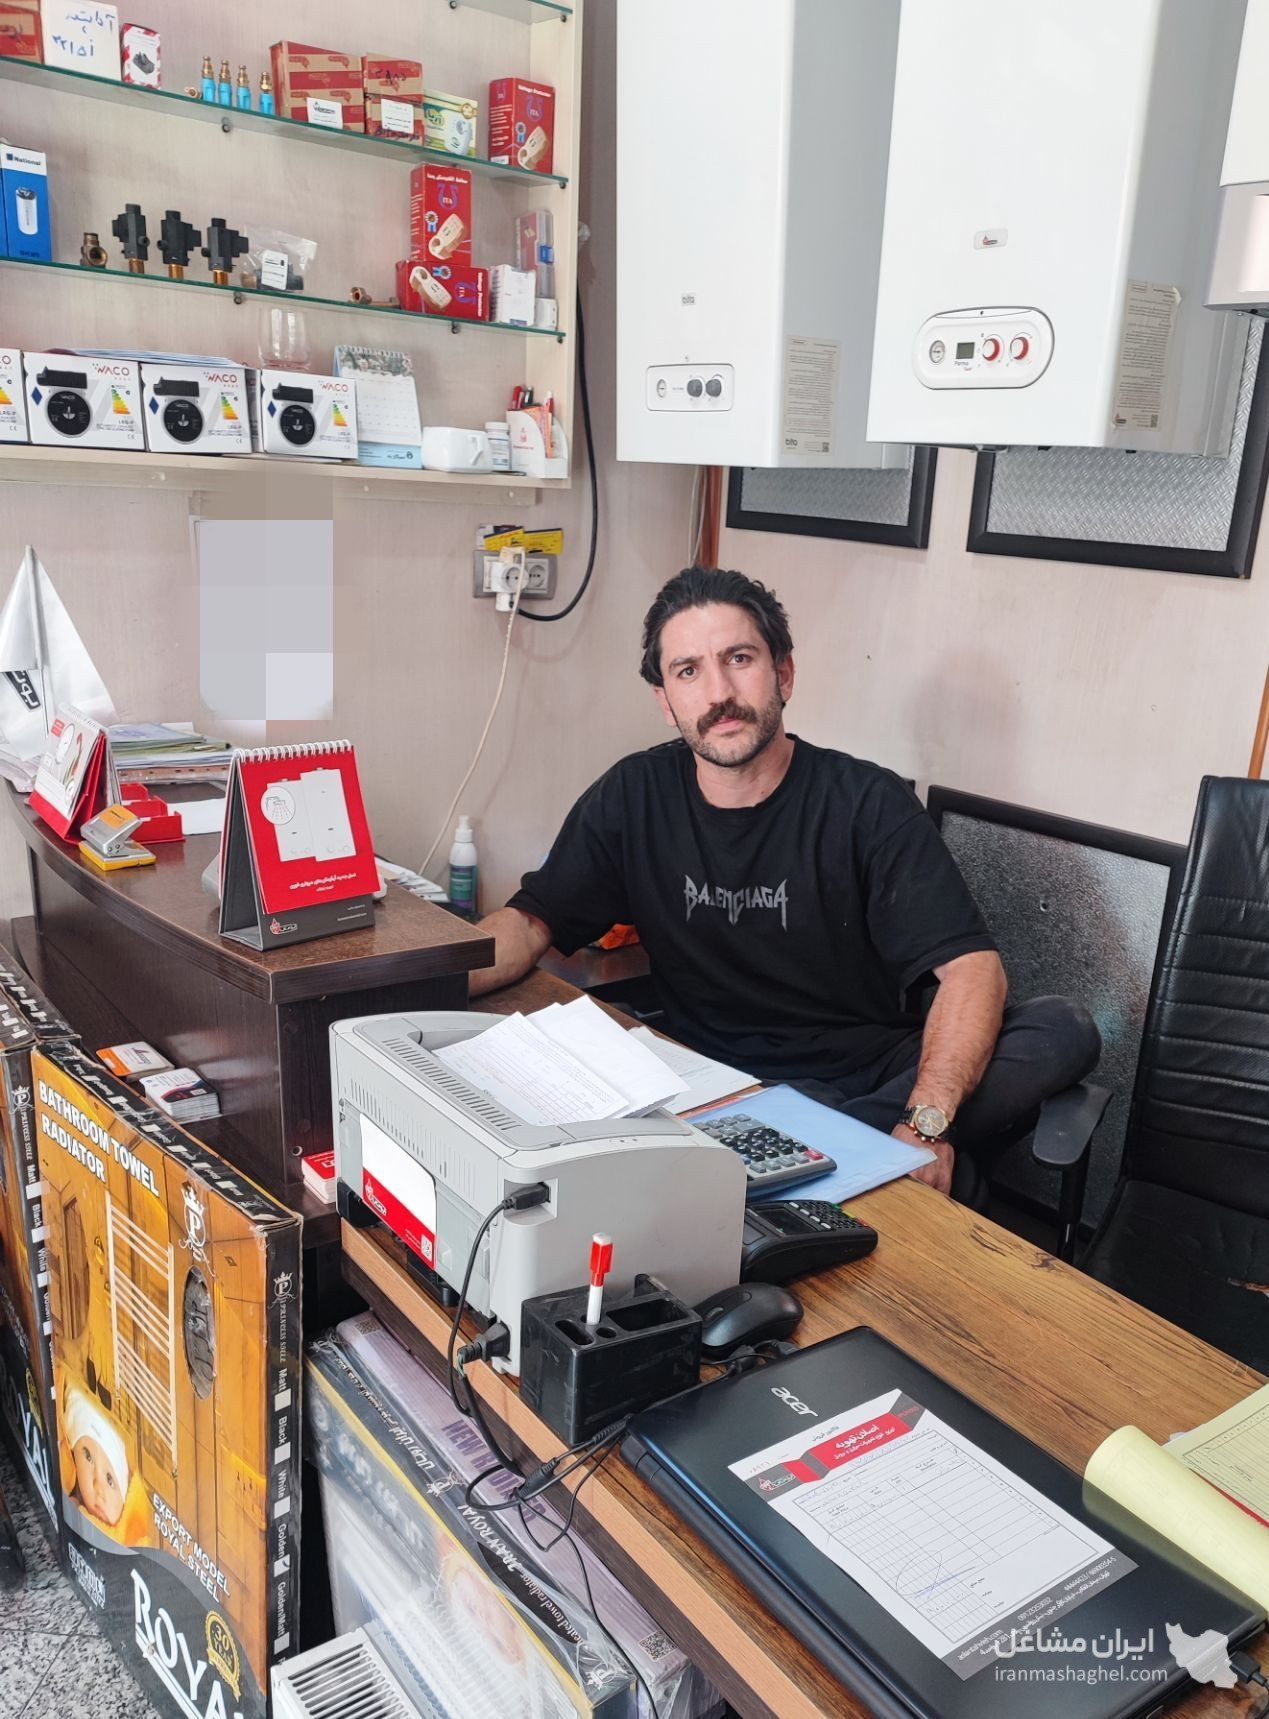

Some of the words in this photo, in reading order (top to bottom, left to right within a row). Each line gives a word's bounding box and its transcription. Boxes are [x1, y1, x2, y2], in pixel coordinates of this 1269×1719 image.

[14, 156, 41, 166] National
[97, 365, 130, 376] WACO
[207, 373, 238, 384] WACO
[321, 382, 349, 393] WACO
[683, 874, 789, 932] BALENCIAGA
[38, 1081, 110, 1155] BATHROOM
[110, 1138, 160, 1197] TOWEL
[41, 1114, 106, 1182] RADIATOR
[26, 1164, 36, 1184] Matt
[32, 1204, 42, 1232] Black
[37, 1247, 47, 1273] White
[278, 1368, 288, 1391] Matt
[771, 1387, 818, 1417] acer
[278, 1415, 288, 1445] Black
[442, 1416, 483, 1458] NEW
[278, 1469, 287, 1498] White
[153, 1494, 192, 1551] EXPORT
[193, 1541, 231, 1596] MODEL
[278, 1523, 286, 1558] Golden
[153, 1513, 186, 1566] ROYAL
[186, 1555, 220, 1602] STEEL
[517, 1572, 546, 1602] radiator
[542, 1600, 563, 1622] towel
[130, 1568, 244, 1719] ROYA
[214, 1624, 230, 1651] 30
[560, 1619, 584, 1645] heated
